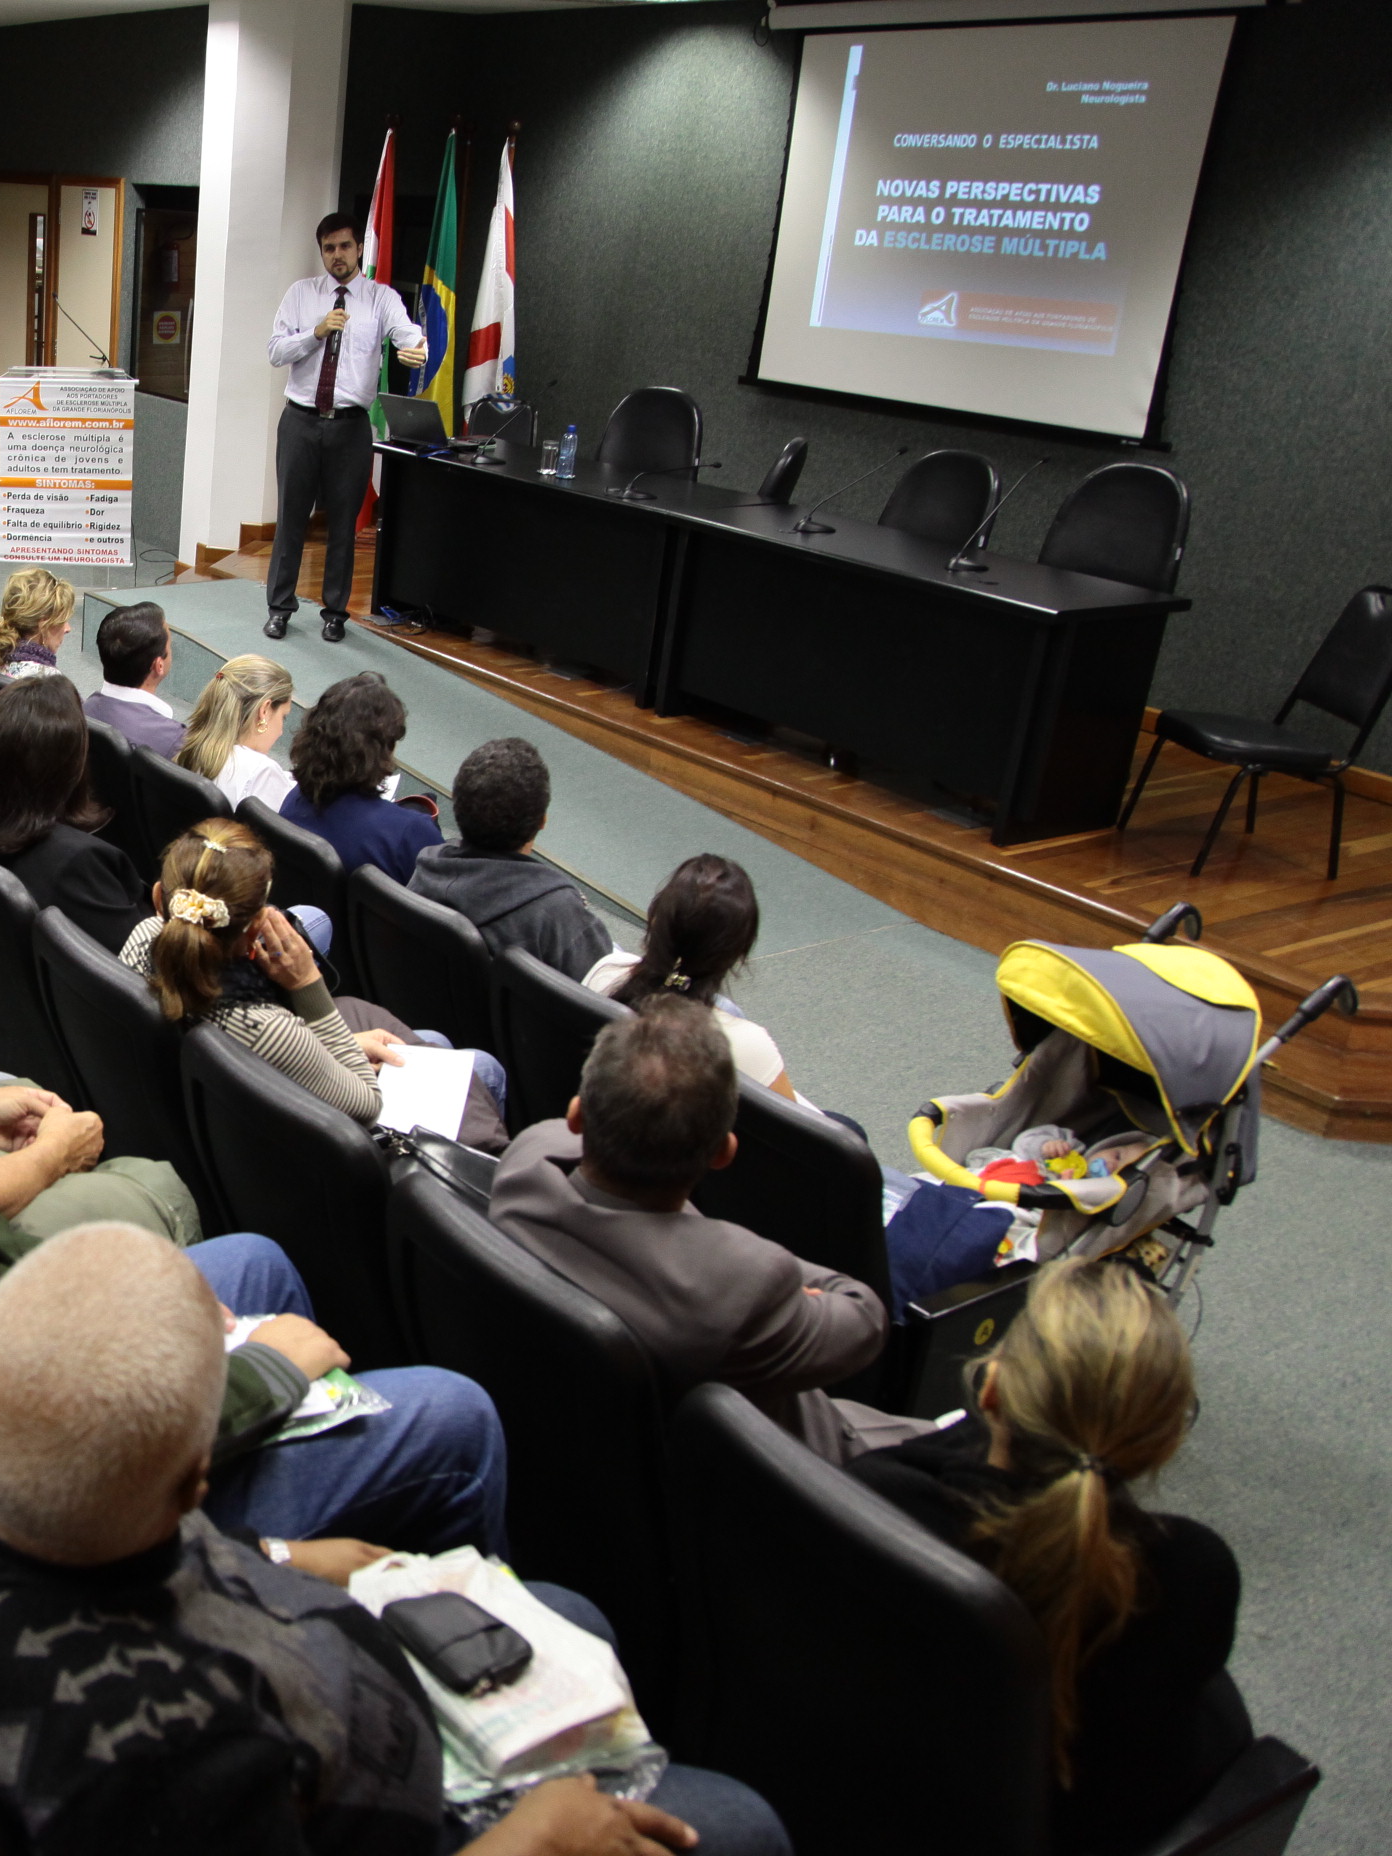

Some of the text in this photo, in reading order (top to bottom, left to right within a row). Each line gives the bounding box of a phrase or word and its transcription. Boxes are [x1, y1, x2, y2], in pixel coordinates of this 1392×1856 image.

[1046, 80, 1149, 93] Dr. Luciano Nogueira
[1080, 94, 1147, 106] Neurologista
[893, 133, 1099, 150] CONVERSANDO O ESPECIALISTA
[876, 179, 1101, 205] NOVAS PERSPECTIVAS
[876, 204, 1091, 232] PARA O TRATAMENTO
[854, 228, 1107, 261] DA ESCLEROSE MÚLTIPLA
[8, 418, 125, 429] www.aflorem.com.br
[7, 432, 124, 443] A esclerose múltipla é
[31, 443, 65, 454] doença
[69, 443, 124, 455] neurológica
[7, 454, 46, 462] crônica
[54, 454, 67, 463] de
[74, 455, 110, 465] jovens
[7, 464, 41, 473] adultos
[51, 465, 68, 474] tem
[71, 465, 123, 475] tratamento.
[35, 479, 95, 489] SINTOMAS:
[6, 492, 69, 502] Perda de visão
[89, 494, 119, 504] Fadiga
[6, 505, 45, 516] Fraqueza
[90, 508, 105, 516] Dor
[6, 519, 28, 528] Falta
[30, 520, 41, 528] de
[89, 522, 121, 532] Rigidez
[6, 533, 52, 542] Dormência
[97, 536, 125, 544] outros
[10, 546, 119, 556] APRESENTANDO SINTOMAS
[63, 555, 125, 564] NEUROLOGISTA
